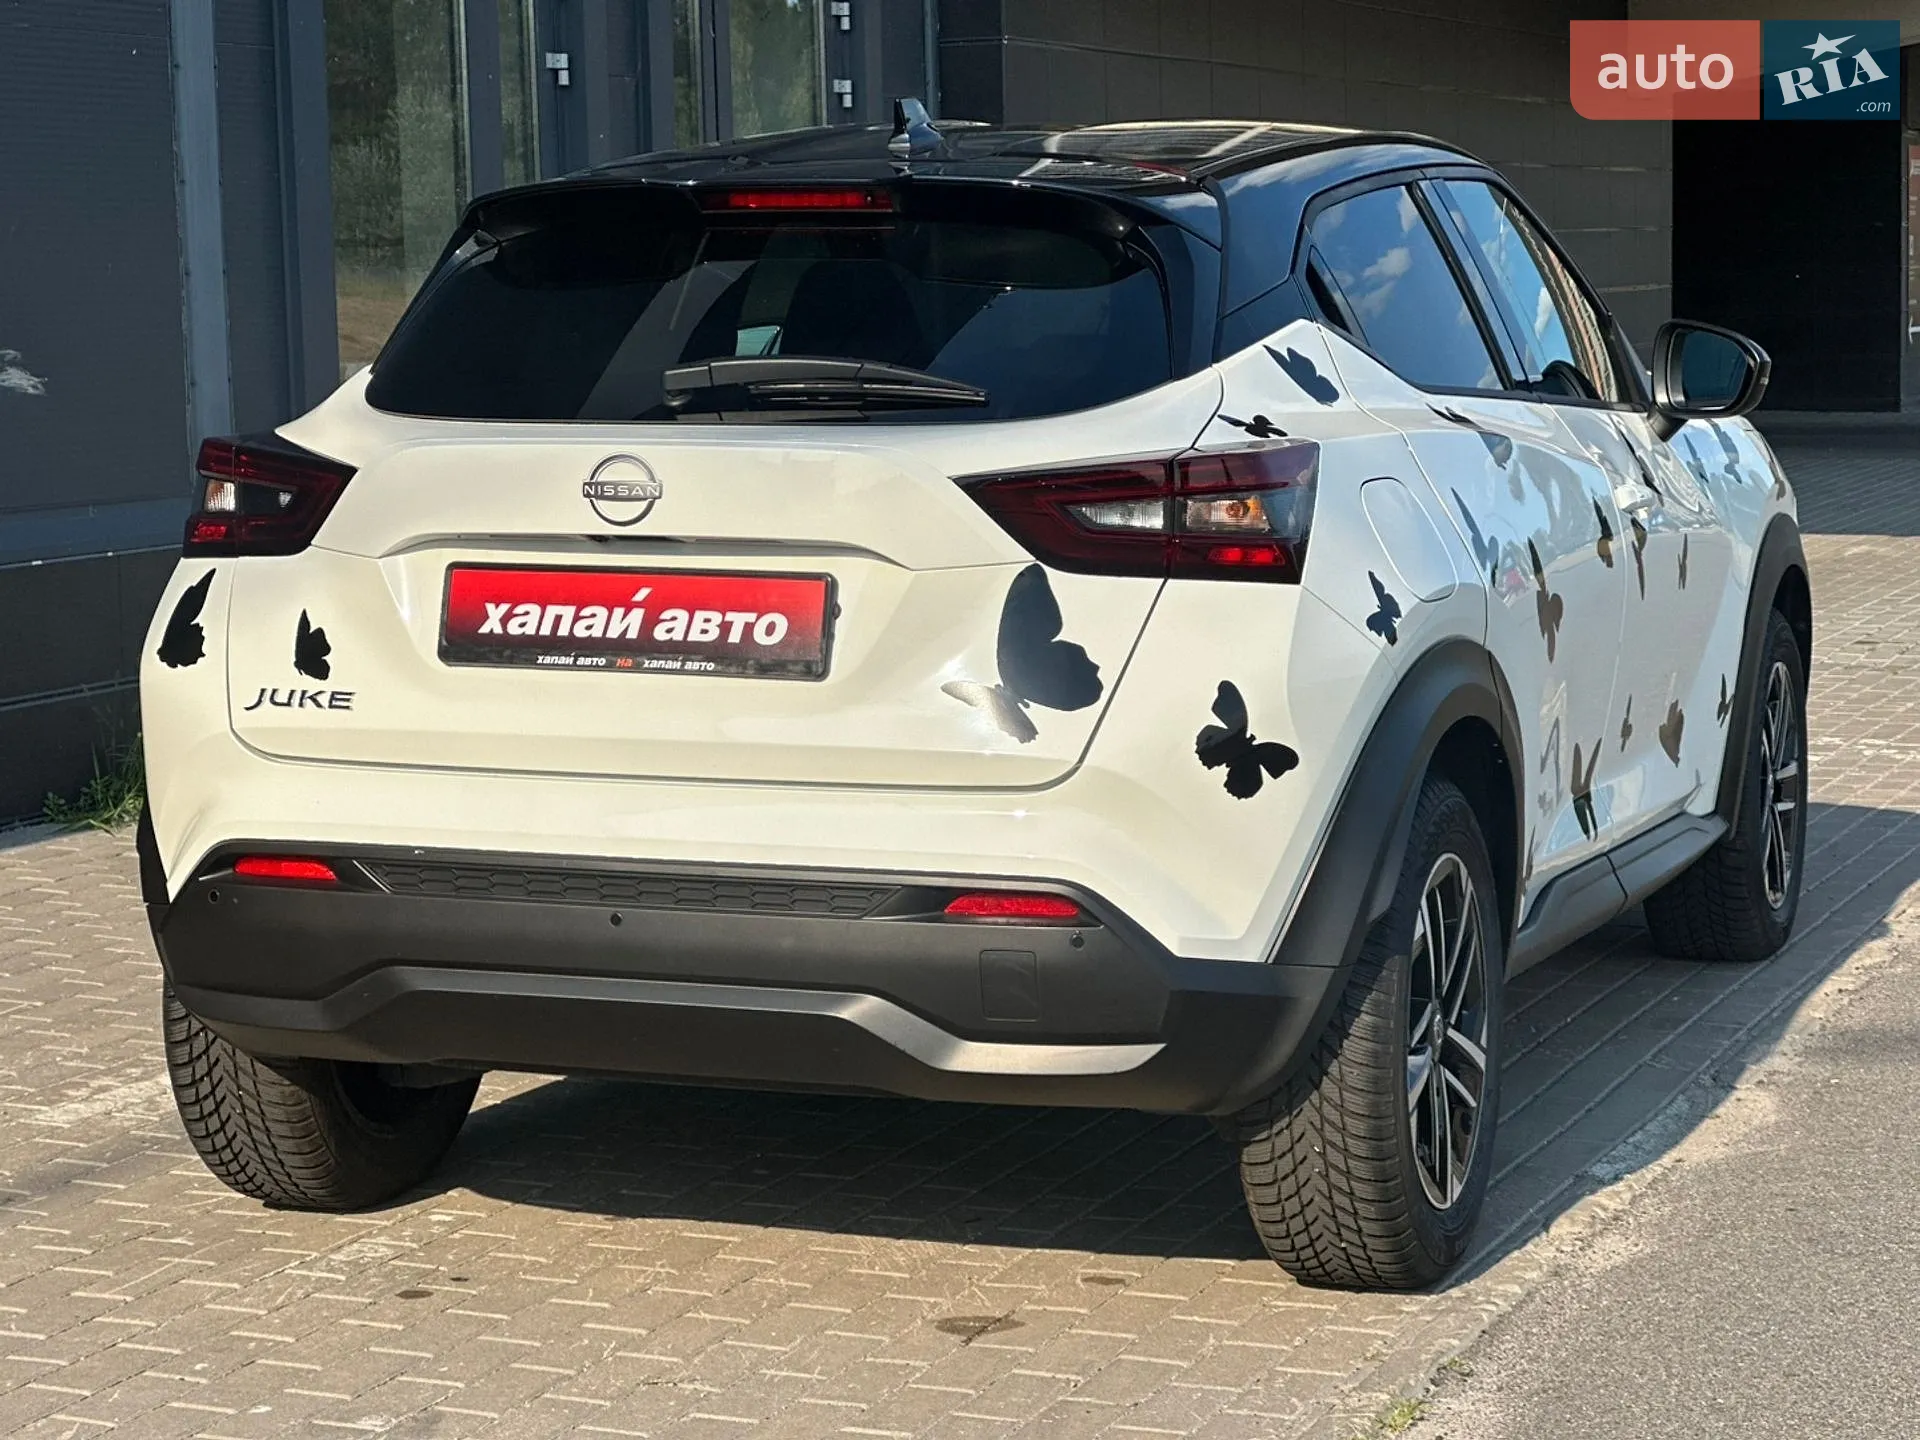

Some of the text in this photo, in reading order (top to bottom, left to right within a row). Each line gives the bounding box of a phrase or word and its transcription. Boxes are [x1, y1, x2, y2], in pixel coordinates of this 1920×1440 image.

[584, 485, 660, 496] NISSAN
[477, 586, 789, 645] хапай авто
[576, 657, 606, 667] авто
[615, 658, 633, 668] на
[684, 661, 715, 671] авто
[243, 688, 357, 711] JUKE
